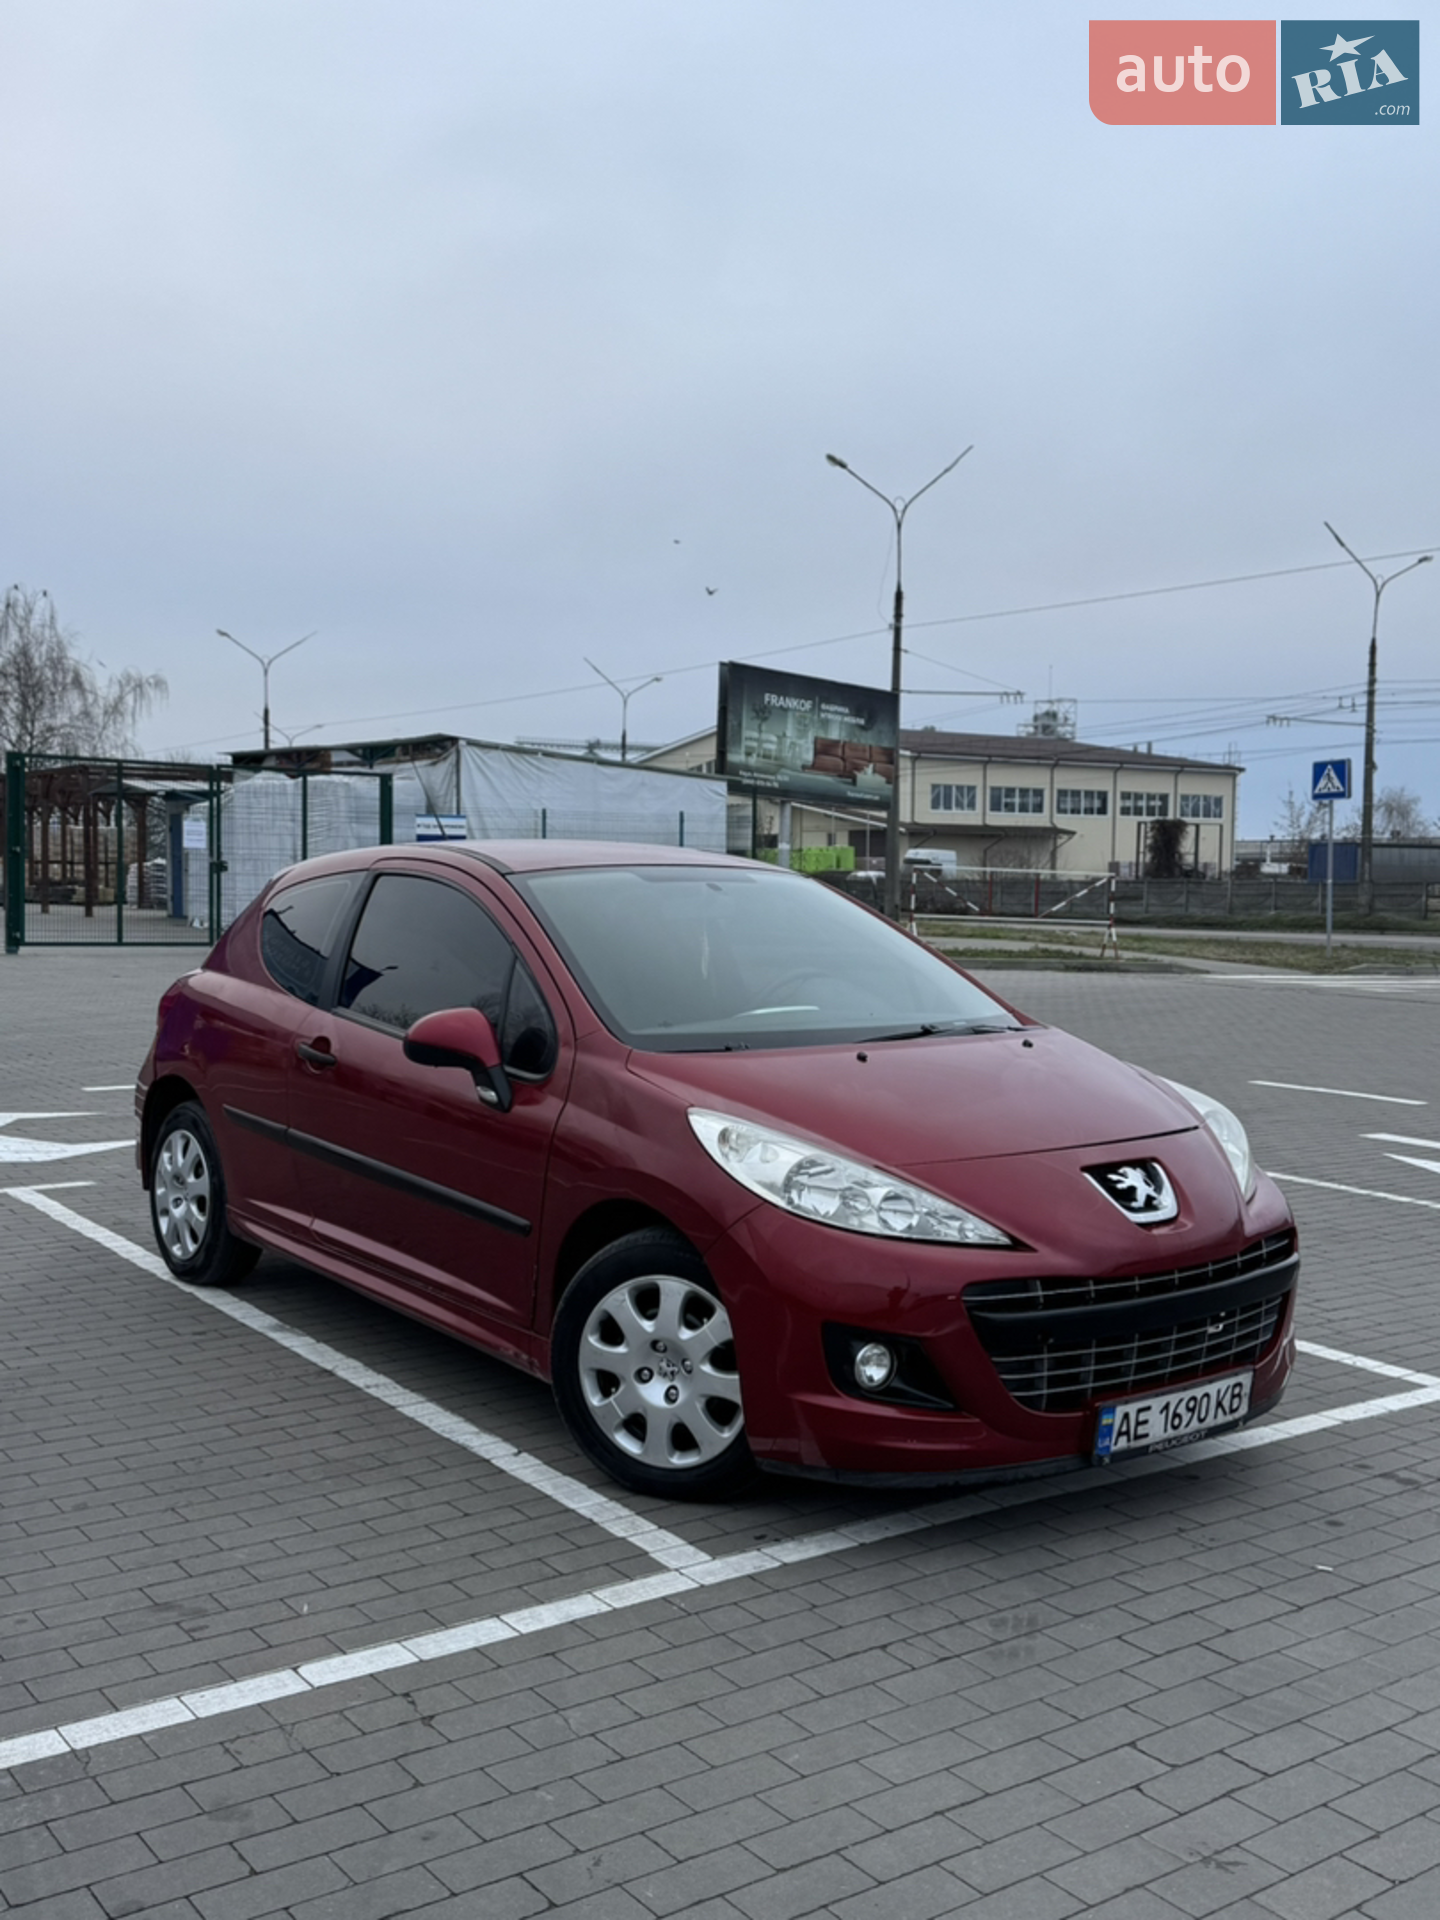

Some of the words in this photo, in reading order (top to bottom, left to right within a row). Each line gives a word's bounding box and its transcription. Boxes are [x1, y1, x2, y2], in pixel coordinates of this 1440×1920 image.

[763, 692, 813, 712] FRANKOF
[1113, 1405, 1152, 1447] AE
[1159, 1391, 1211, 1434] 1690
[1213, 1381, 1244, 1420] KB
